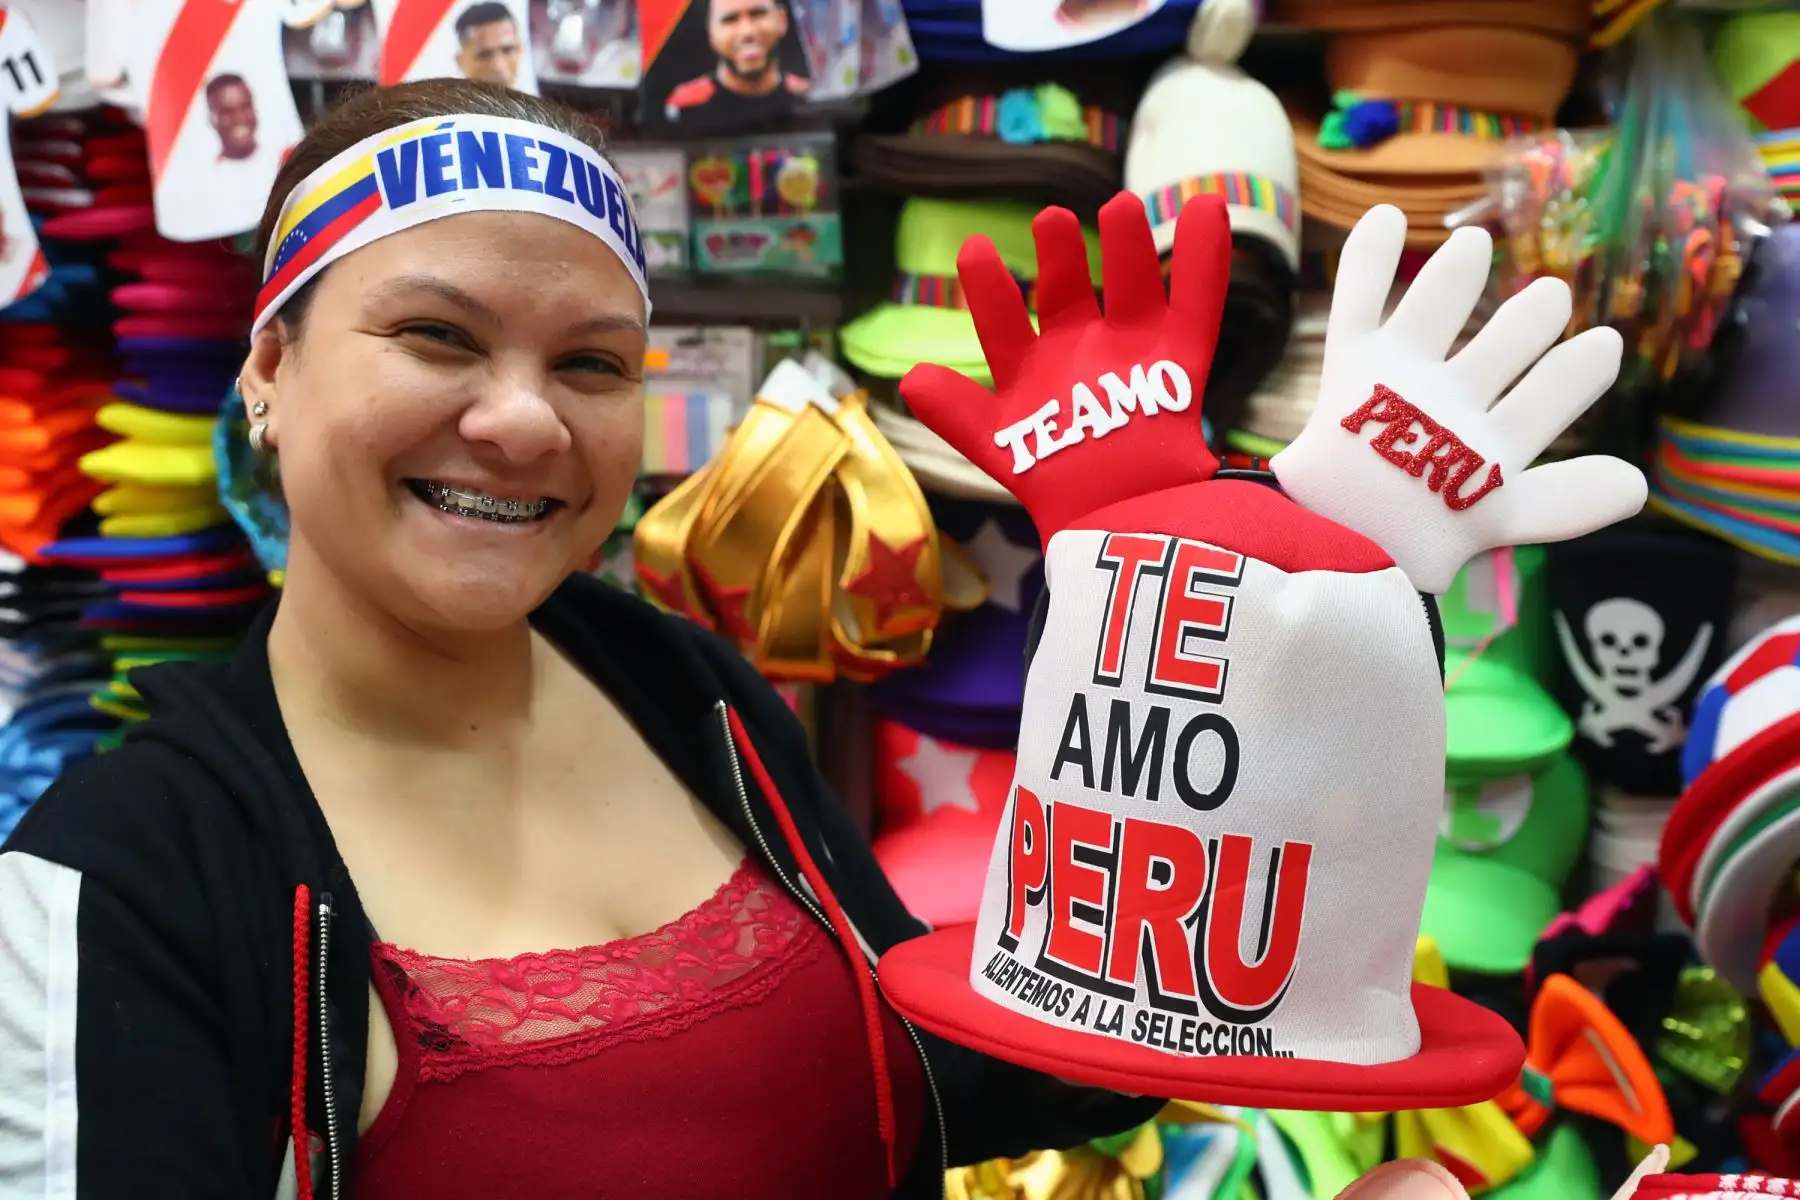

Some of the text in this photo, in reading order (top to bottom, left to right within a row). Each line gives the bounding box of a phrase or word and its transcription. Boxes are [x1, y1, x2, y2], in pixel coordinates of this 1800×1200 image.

[1, 51, 43, 93] 11
[1340, 383, 1504, 511] PERU
[1093, 532, 1245, 704] TE
[1050, 692, 1241, 812] AMO
[998, 784, 1313, 1025] PERU
[981, 953, 1074, 1018] ALIENTEMOS
[1072, 994, 1091, 1026] A
[1093, 999, 1125, 1037] LA
